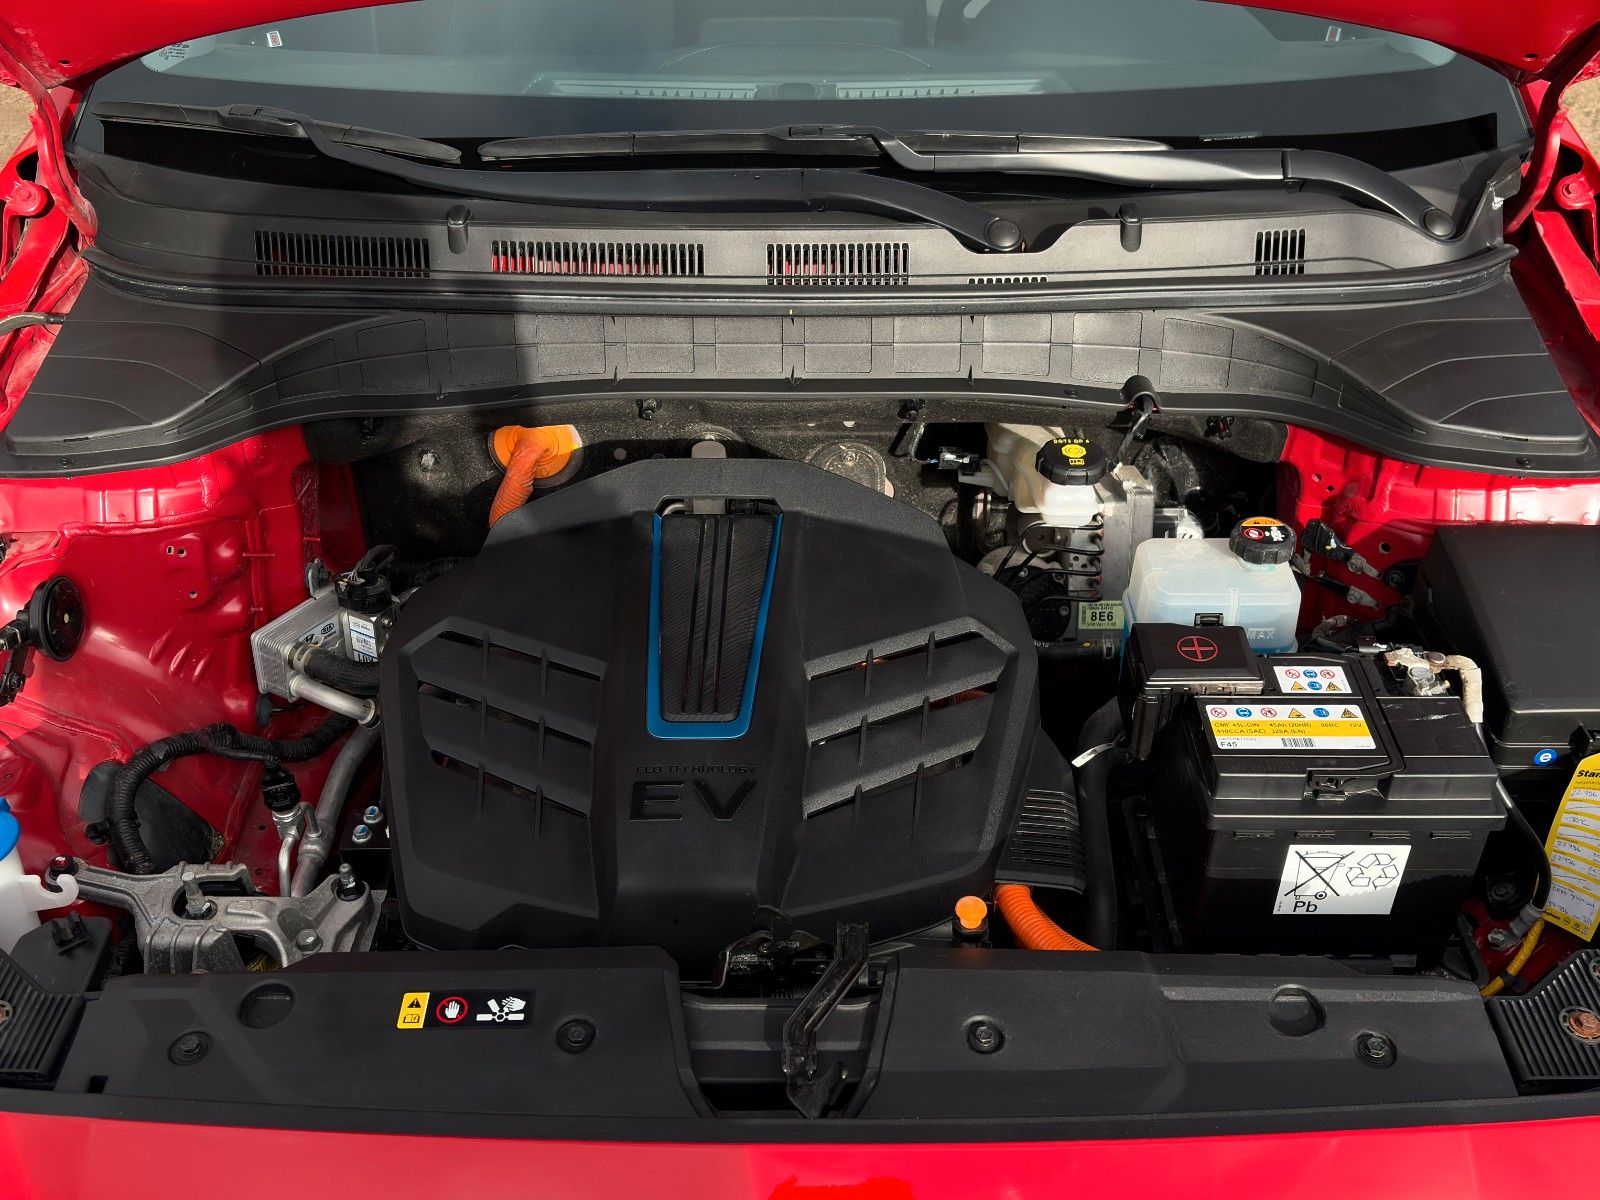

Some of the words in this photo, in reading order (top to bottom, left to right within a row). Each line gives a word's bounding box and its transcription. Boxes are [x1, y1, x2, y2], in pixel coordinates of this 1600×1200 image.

[1090, 611, 1114, 621] 8E6
[636, 765, 662, 774] ECO
[667, 765, 757, 774] TECHNOLOGY
[629, 780, 758, 821] EV
[1292, 900, 1318, 912] Pb
